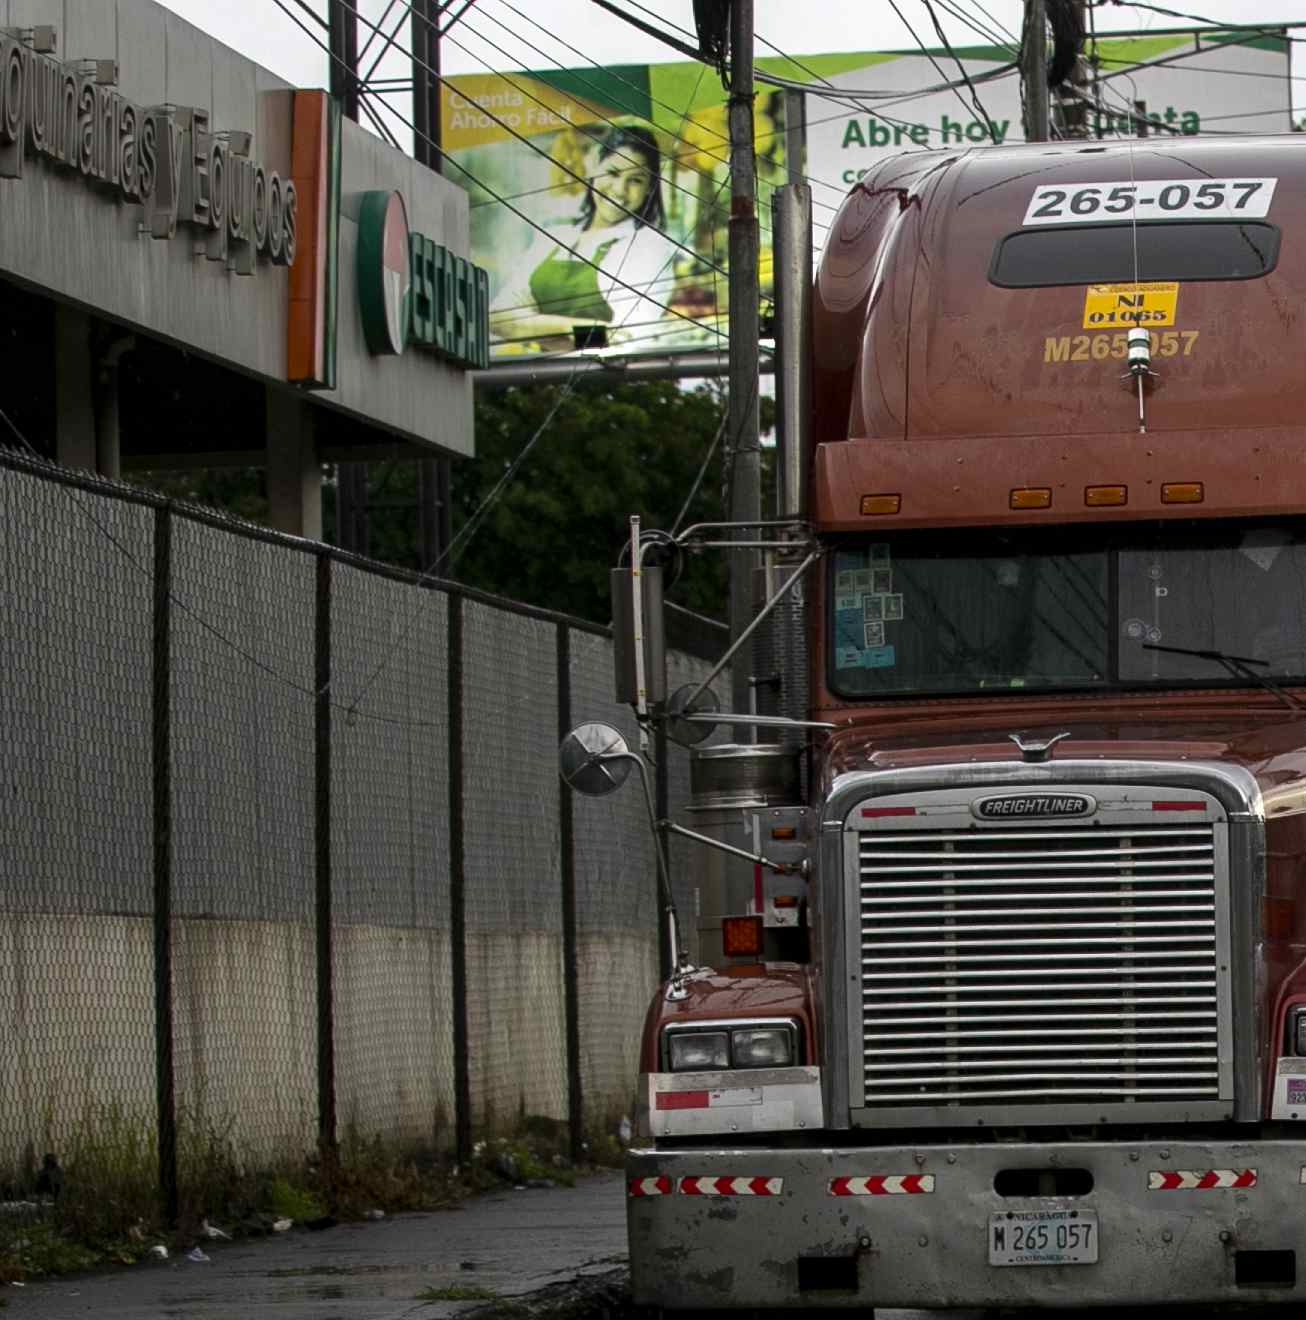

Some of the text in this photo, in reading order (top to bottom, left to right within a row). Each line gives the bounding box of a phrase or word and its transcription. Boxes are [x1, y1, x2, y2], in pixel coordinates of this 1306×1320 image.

[450, 92, 523, 111] Cuenta
[450, 111, 522, 130] Ahorro
[841, 118, 930, 149] Abre
[189, 107, 297, 275] Equipos
[1030, 182, 1264, 218] 265-057
[410, 231, 489, 370] ESCASAN
[1116, 293, 1146, 308] NI
[1088, 310, 1168, 324] 01065
[984, 797, 1084, 815] FREIGHTLINER
[993, 1223, 1093, 1252] M 265 057
